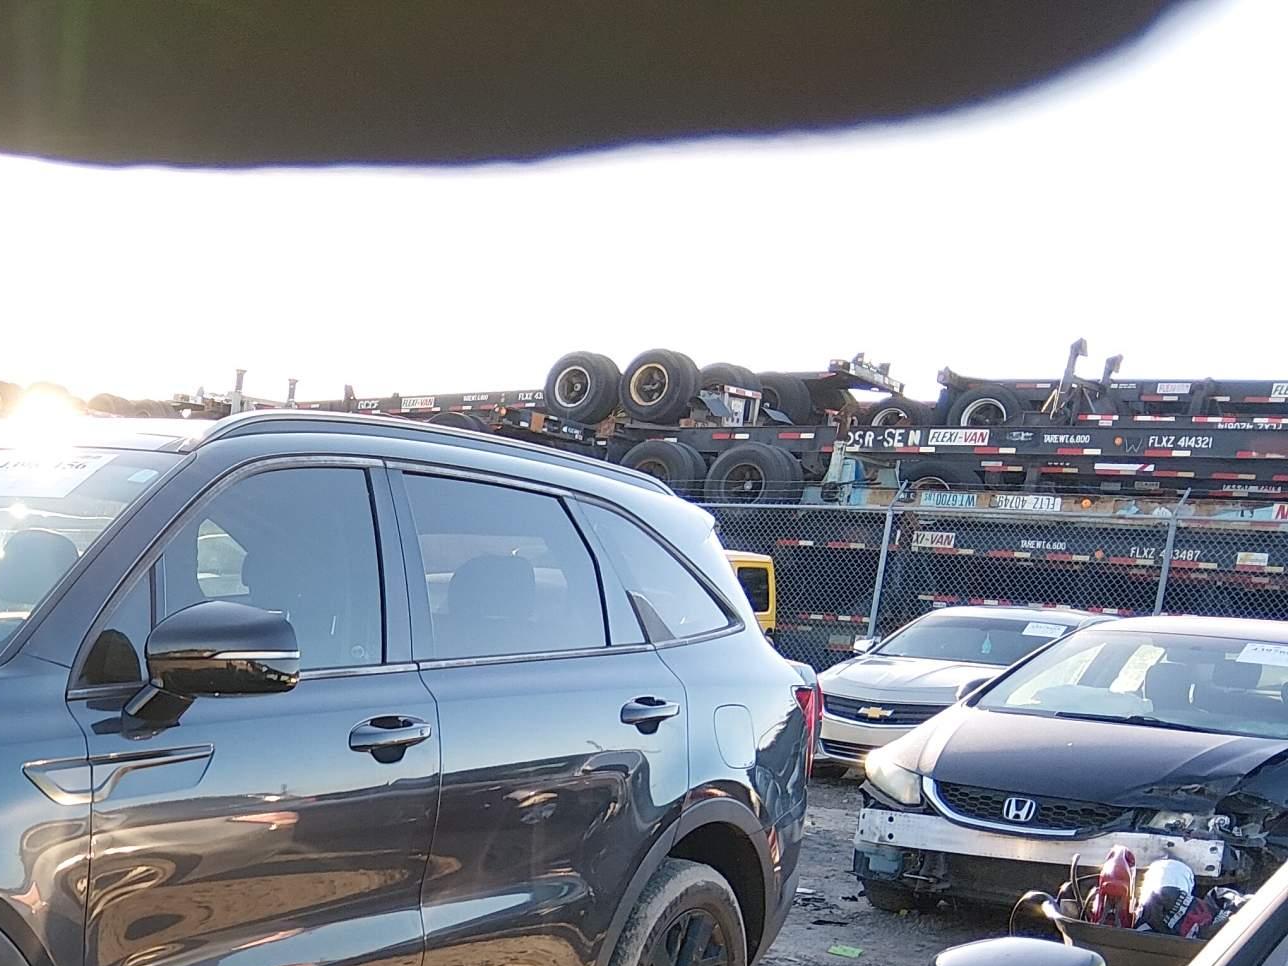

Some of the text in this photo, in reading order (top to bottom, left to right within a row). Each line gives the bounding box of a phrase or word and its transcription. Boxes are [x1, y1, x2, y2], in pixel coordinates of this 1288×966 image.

[930, 431, 987, 444] FLEXI-VAN
[1148, 436, 1213, 448] FLXZ 414321
[1130, 547, 1201, 561] FLXZ 43487
